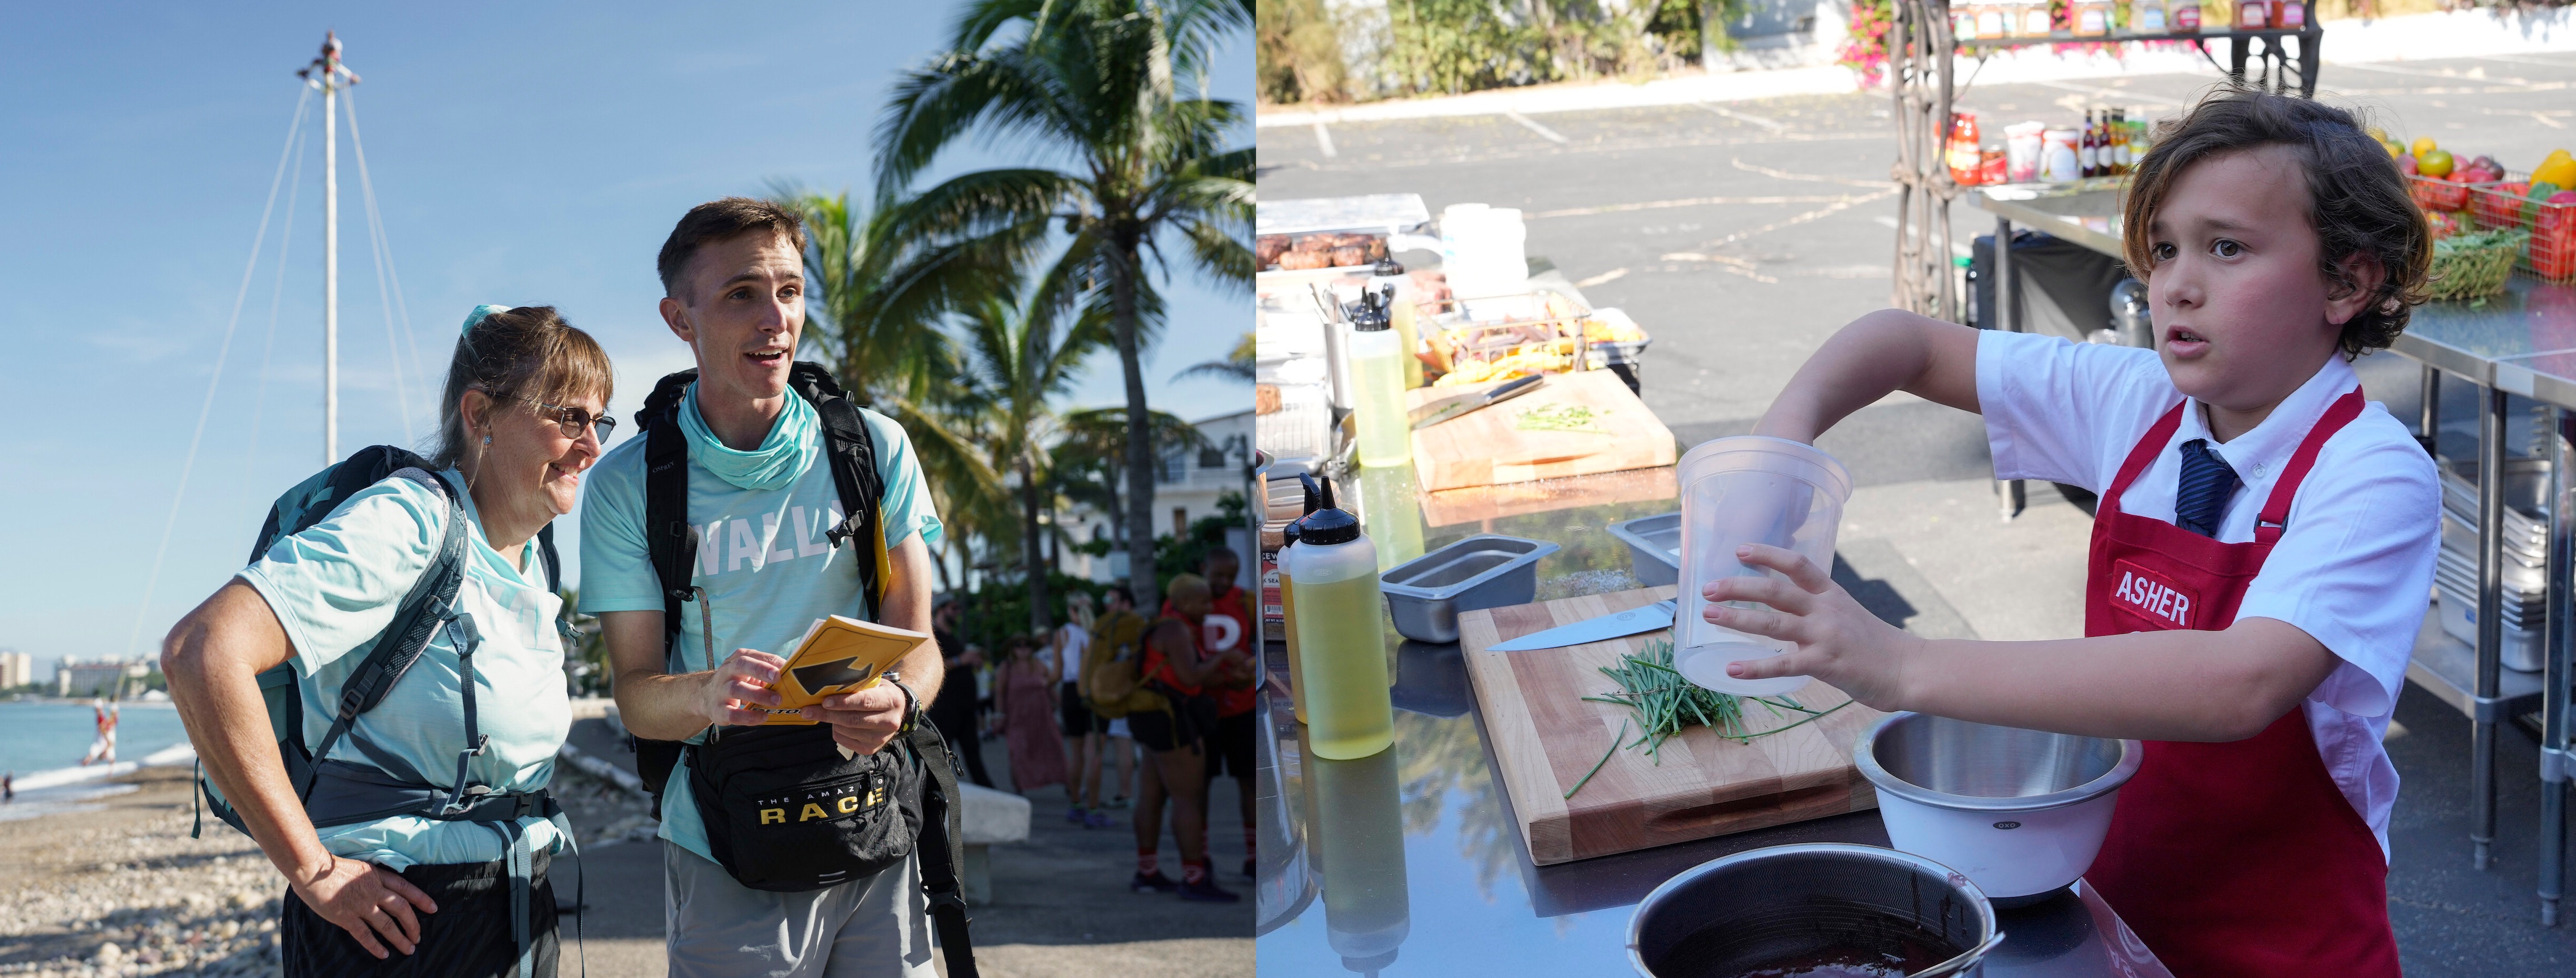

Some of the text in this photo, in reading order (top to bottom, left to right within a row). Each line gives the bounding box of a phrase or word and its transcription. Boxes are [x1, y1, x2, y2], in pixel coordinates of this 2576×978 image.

[652, 460, 674, 473] OSPREY
[2115, 571, 2190, 626] ASHER
[758, 778, 883, 806] THE AMAZIG
[760, 787, 884, 825] RACE
